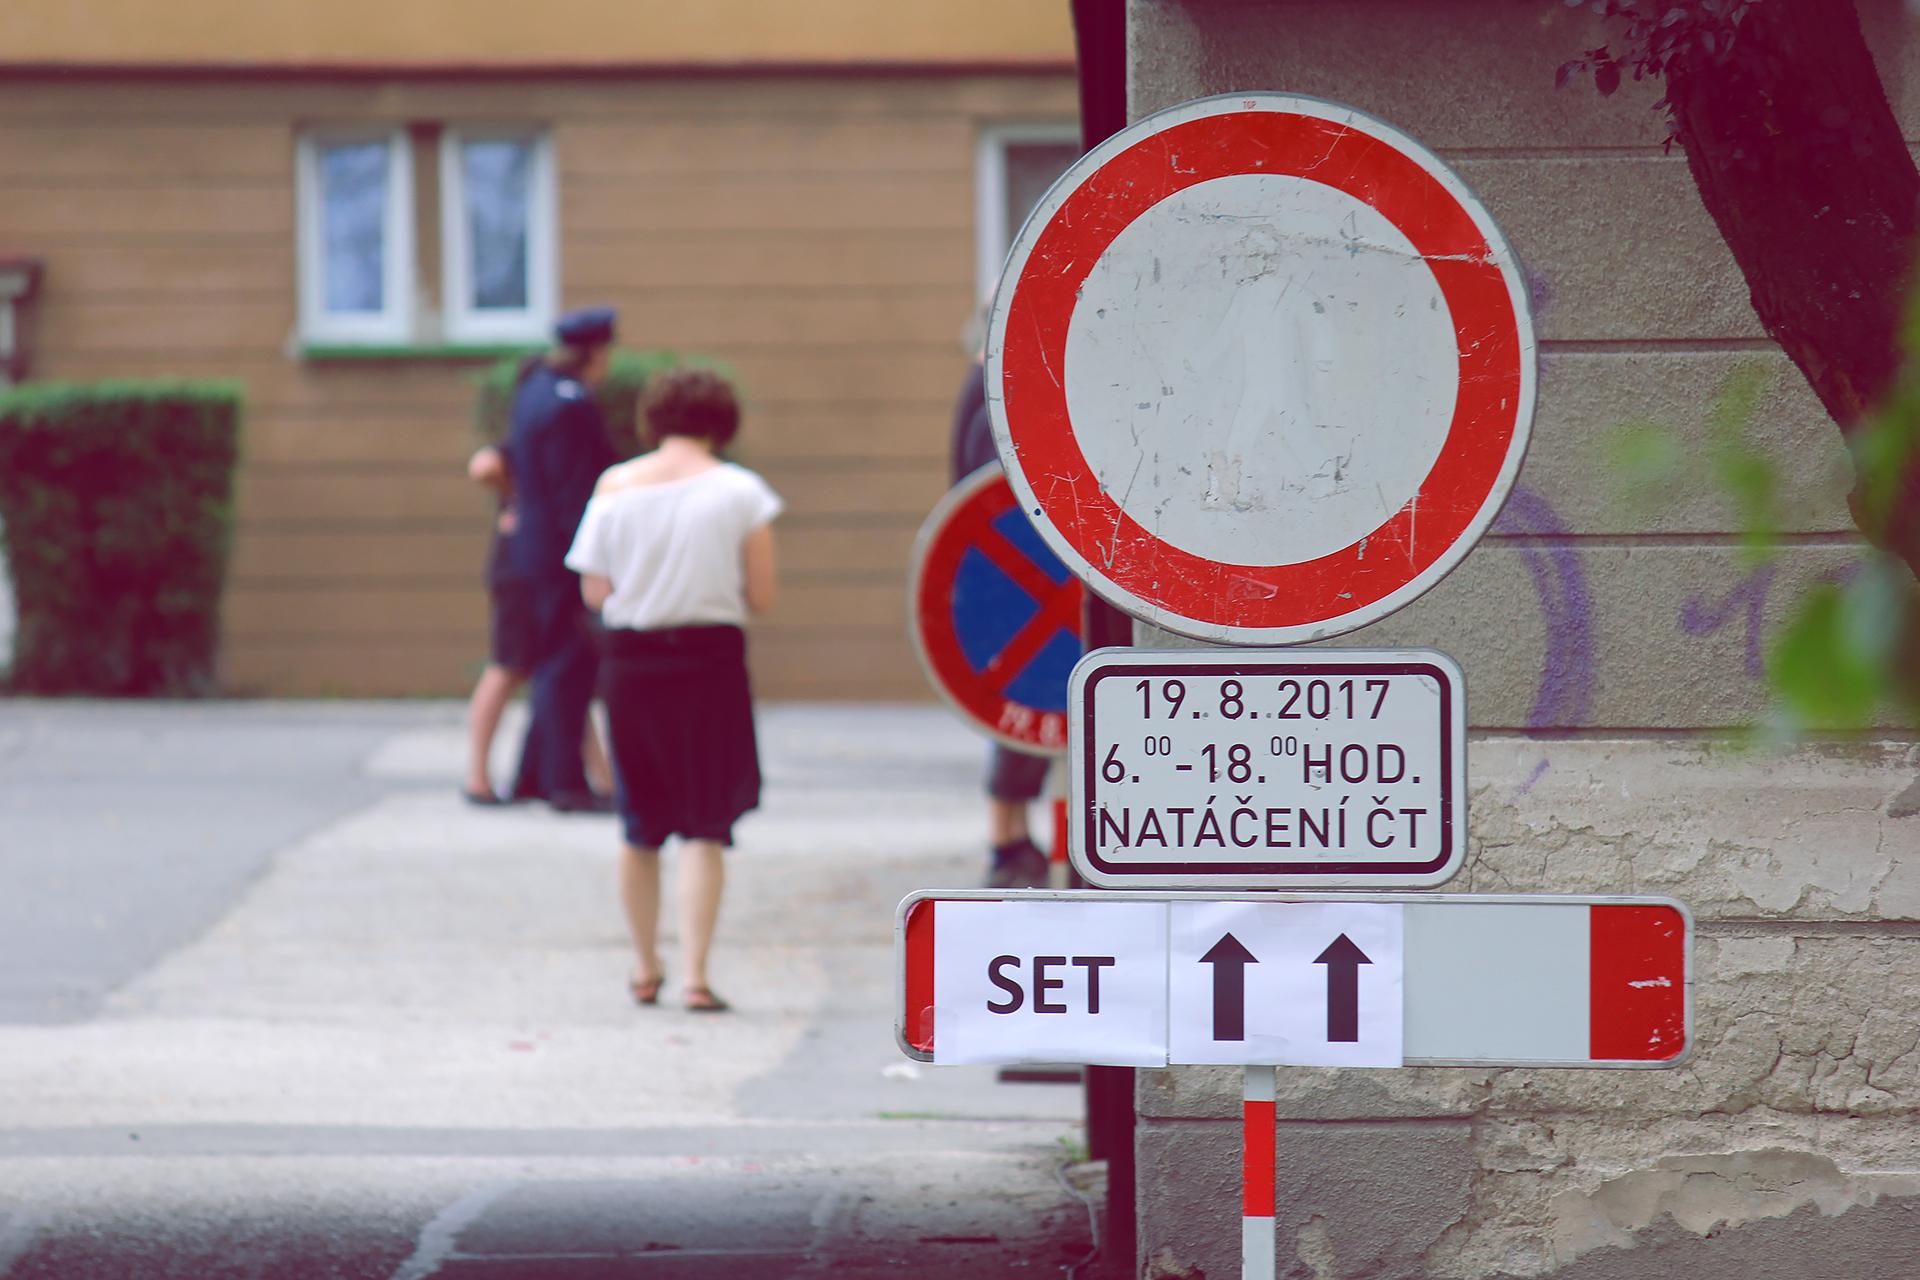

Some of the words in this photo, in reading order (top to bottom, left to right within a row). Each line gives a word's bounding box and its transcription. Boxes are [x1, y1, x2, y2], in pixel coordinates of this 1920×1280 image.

[1136, 679, 1200, 720] 19.
[1219, 679, 1258, 720] 8.
[1277, 679, 1390, 720] 2017
[1303, 743, 1420, 784] HOD.
[1099, 795, 1350, 848] NATÁČENÍ
[1366, 795, 1427, 849] ČT
[987, 955, 1116, 1015] SET
